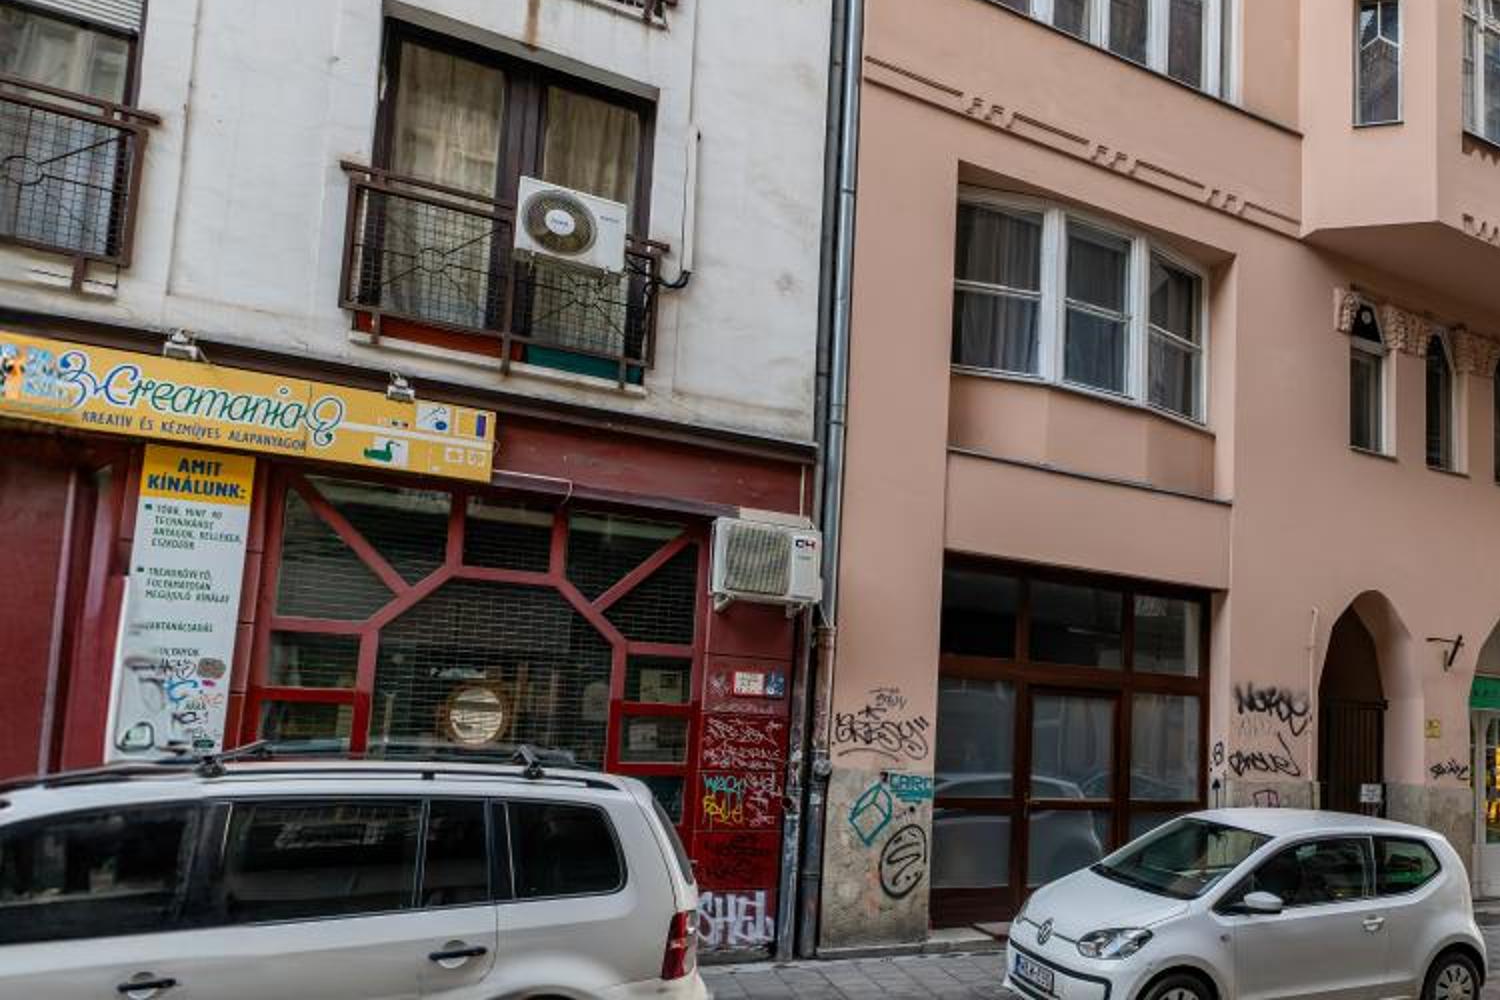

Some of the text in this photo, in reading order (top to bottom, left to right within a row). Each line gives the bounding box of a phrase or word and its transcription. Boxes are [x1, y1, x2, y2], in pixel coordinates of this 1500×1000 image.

[104, 364, 304, 430] Creamania
[139, 412, 153, 431] ÉS
[178, 458, 222, 477] AMIT
[147, 472, 246, 499] KÍNÁLUNK:
